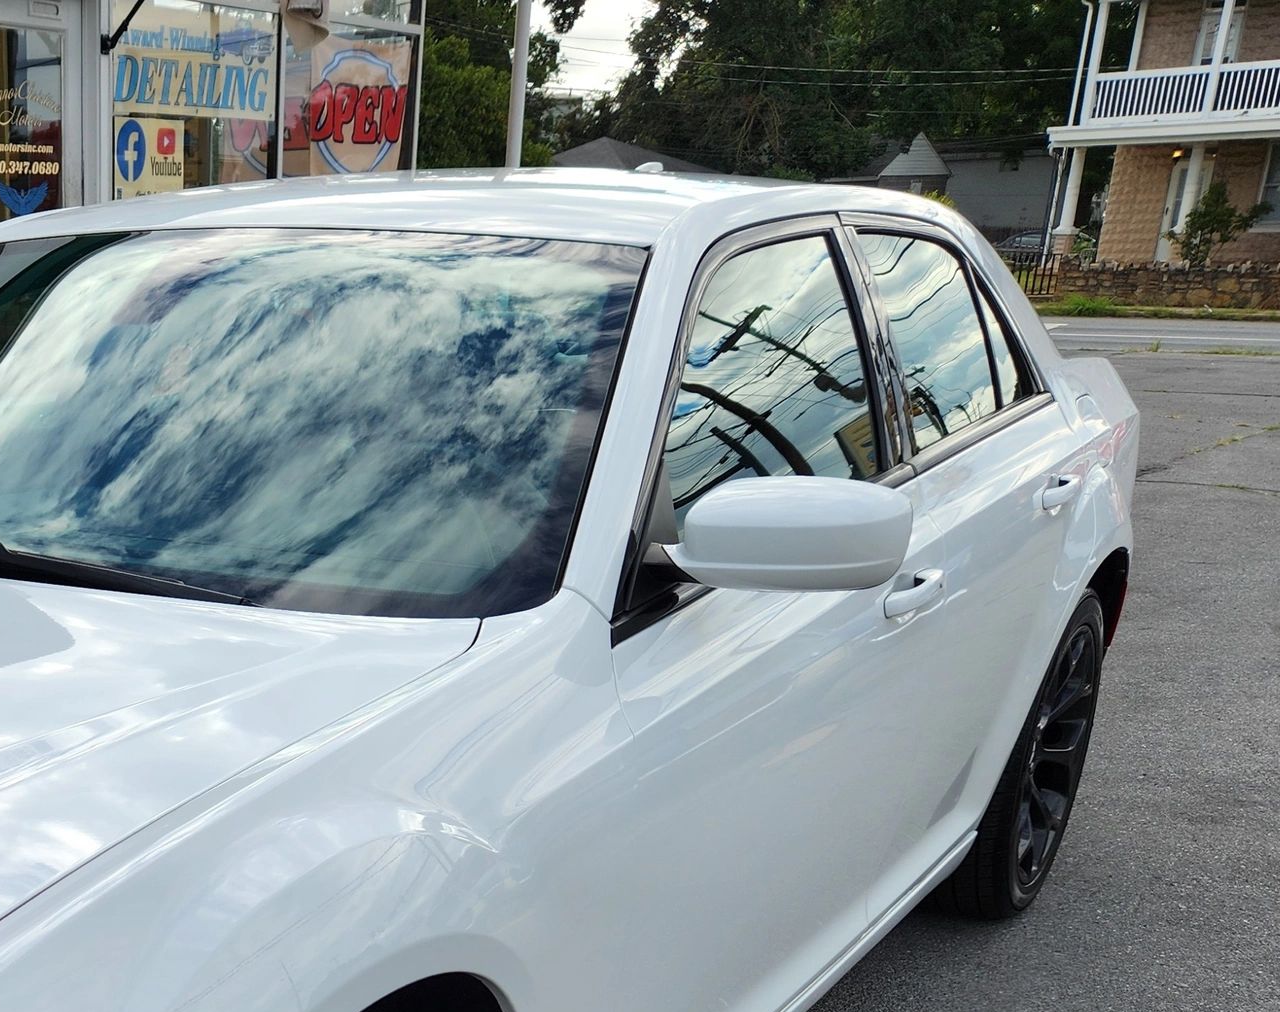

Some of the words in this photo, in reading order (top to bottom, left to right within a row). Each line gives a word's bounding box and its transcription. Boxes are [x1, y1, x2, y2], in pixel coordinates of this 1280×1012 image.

[119, 25, 220, 61] Award-Winning
[114, 54, 269, 113] DETAILING
[308, 80, 408, 144] OPEN
[150, 157, 182, 176] YouTube
